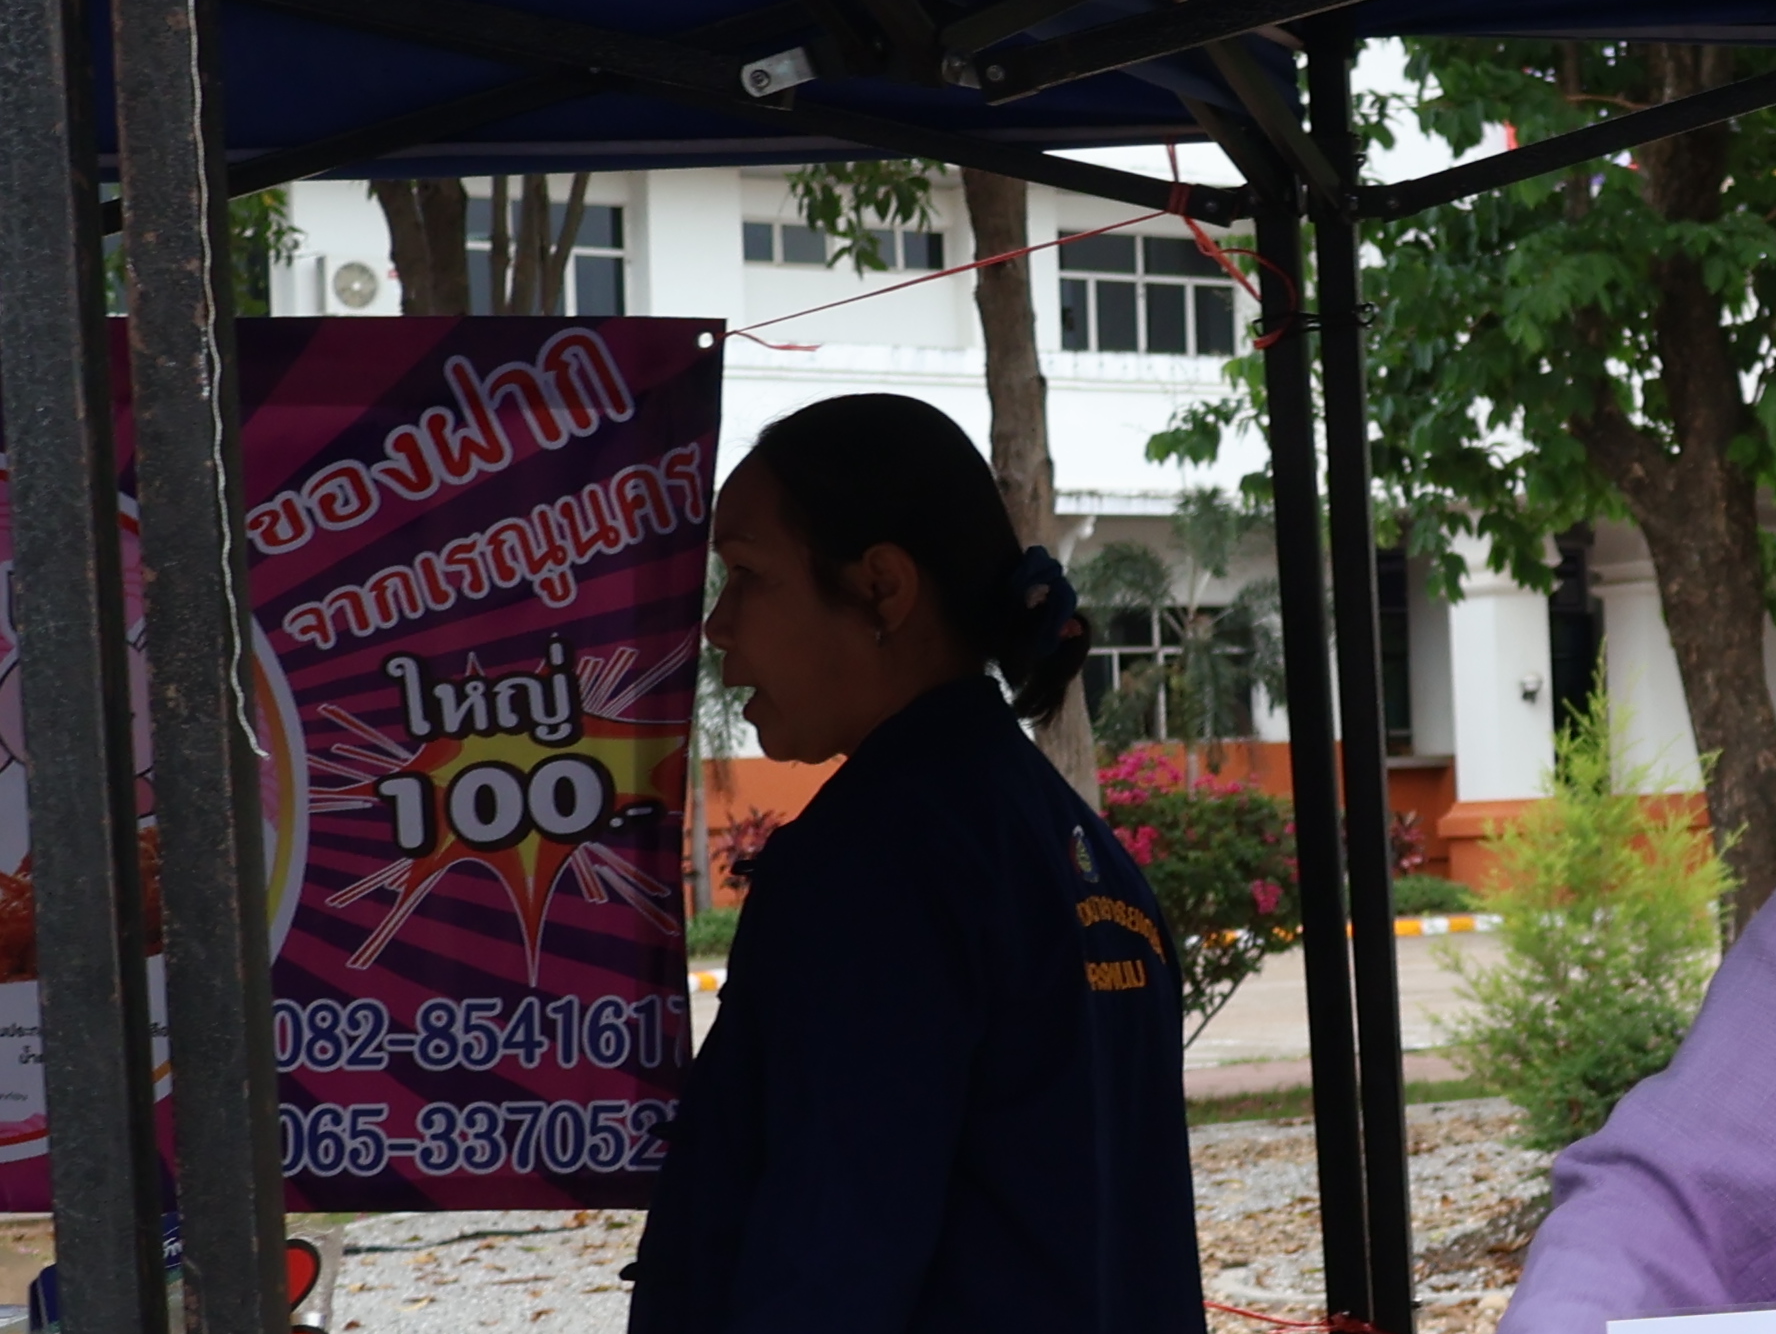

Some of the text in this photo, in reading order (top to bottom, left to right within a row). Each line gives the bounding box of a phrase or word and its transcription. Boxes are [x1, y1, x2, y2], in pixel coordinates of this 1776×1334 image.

[246, 327, 634, 554] ของฝาก
[283, 443, 704, 650] จากเรณูนคร
[387, 633, 573, 741] ใหญ่
[279, 1099, 680, 1177] 065-337052
